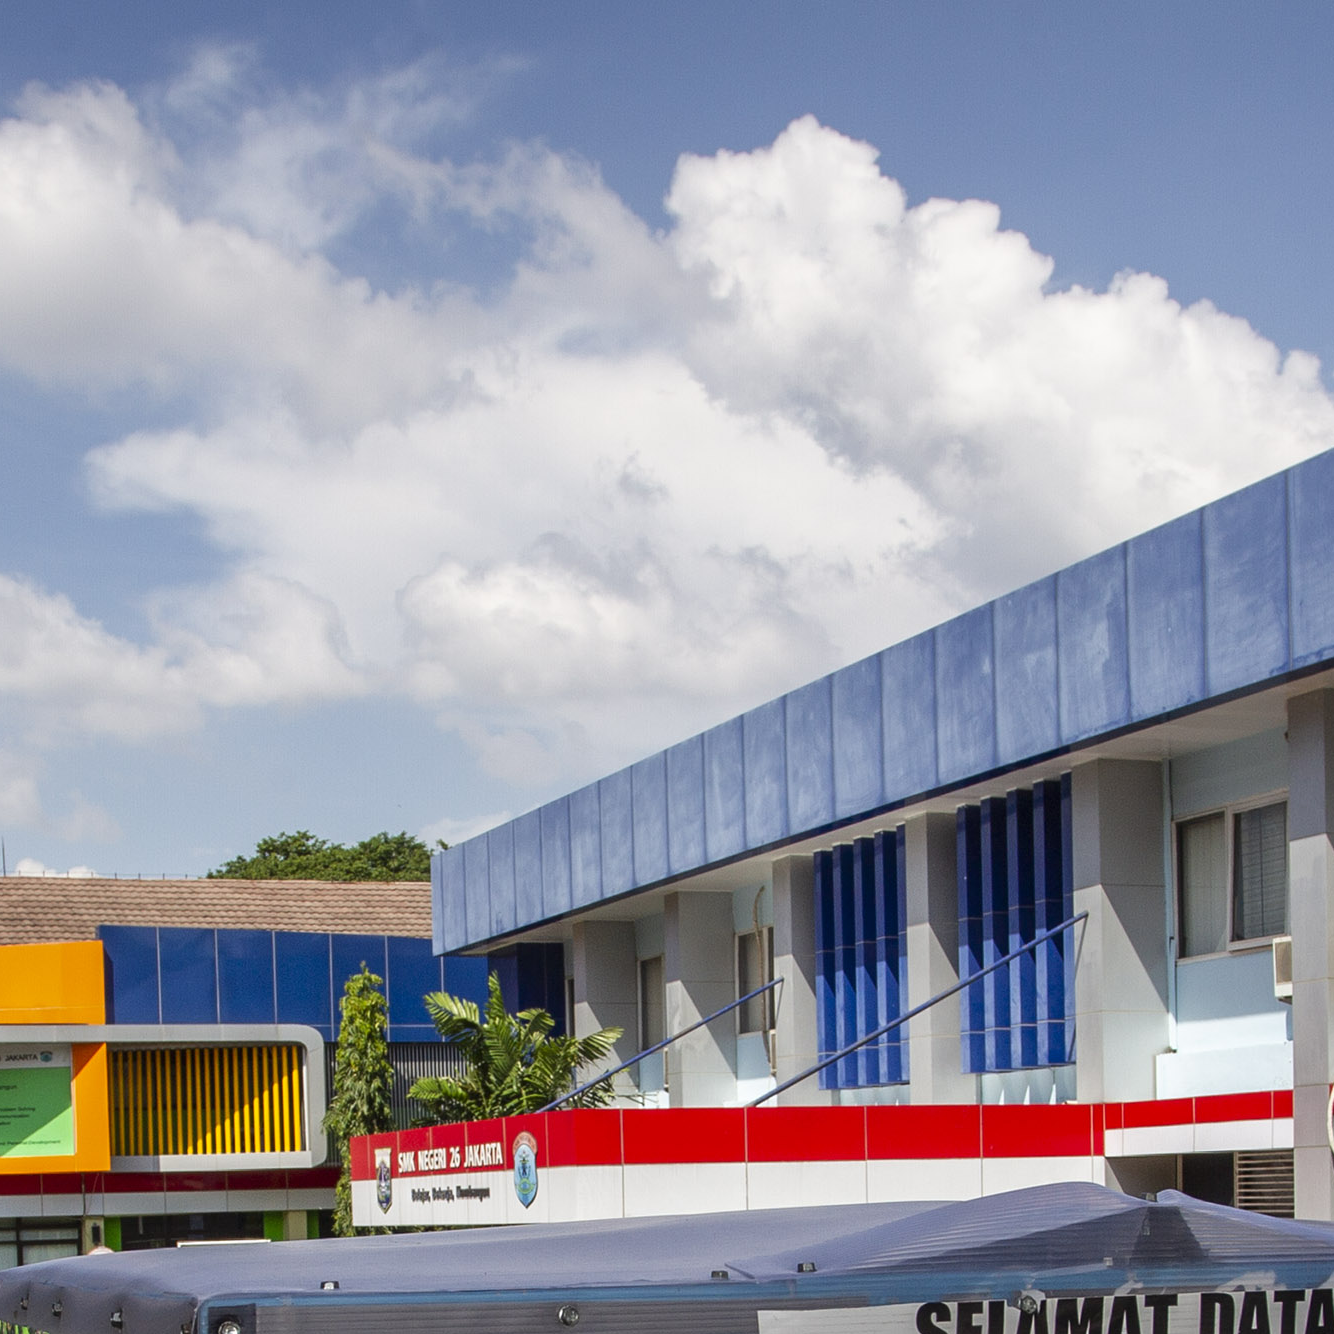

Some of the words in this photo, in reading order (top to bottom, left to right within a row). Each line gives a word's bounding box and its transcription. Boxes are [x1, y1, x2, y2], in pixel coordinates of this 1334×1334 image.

[398, 1151, 416, 1173] SMK
[418, 1147, 447, 1172] NEGERI
[449, 1146, 461, 1168] 26
[463, 1142, 504, 1167] JAKARTA
